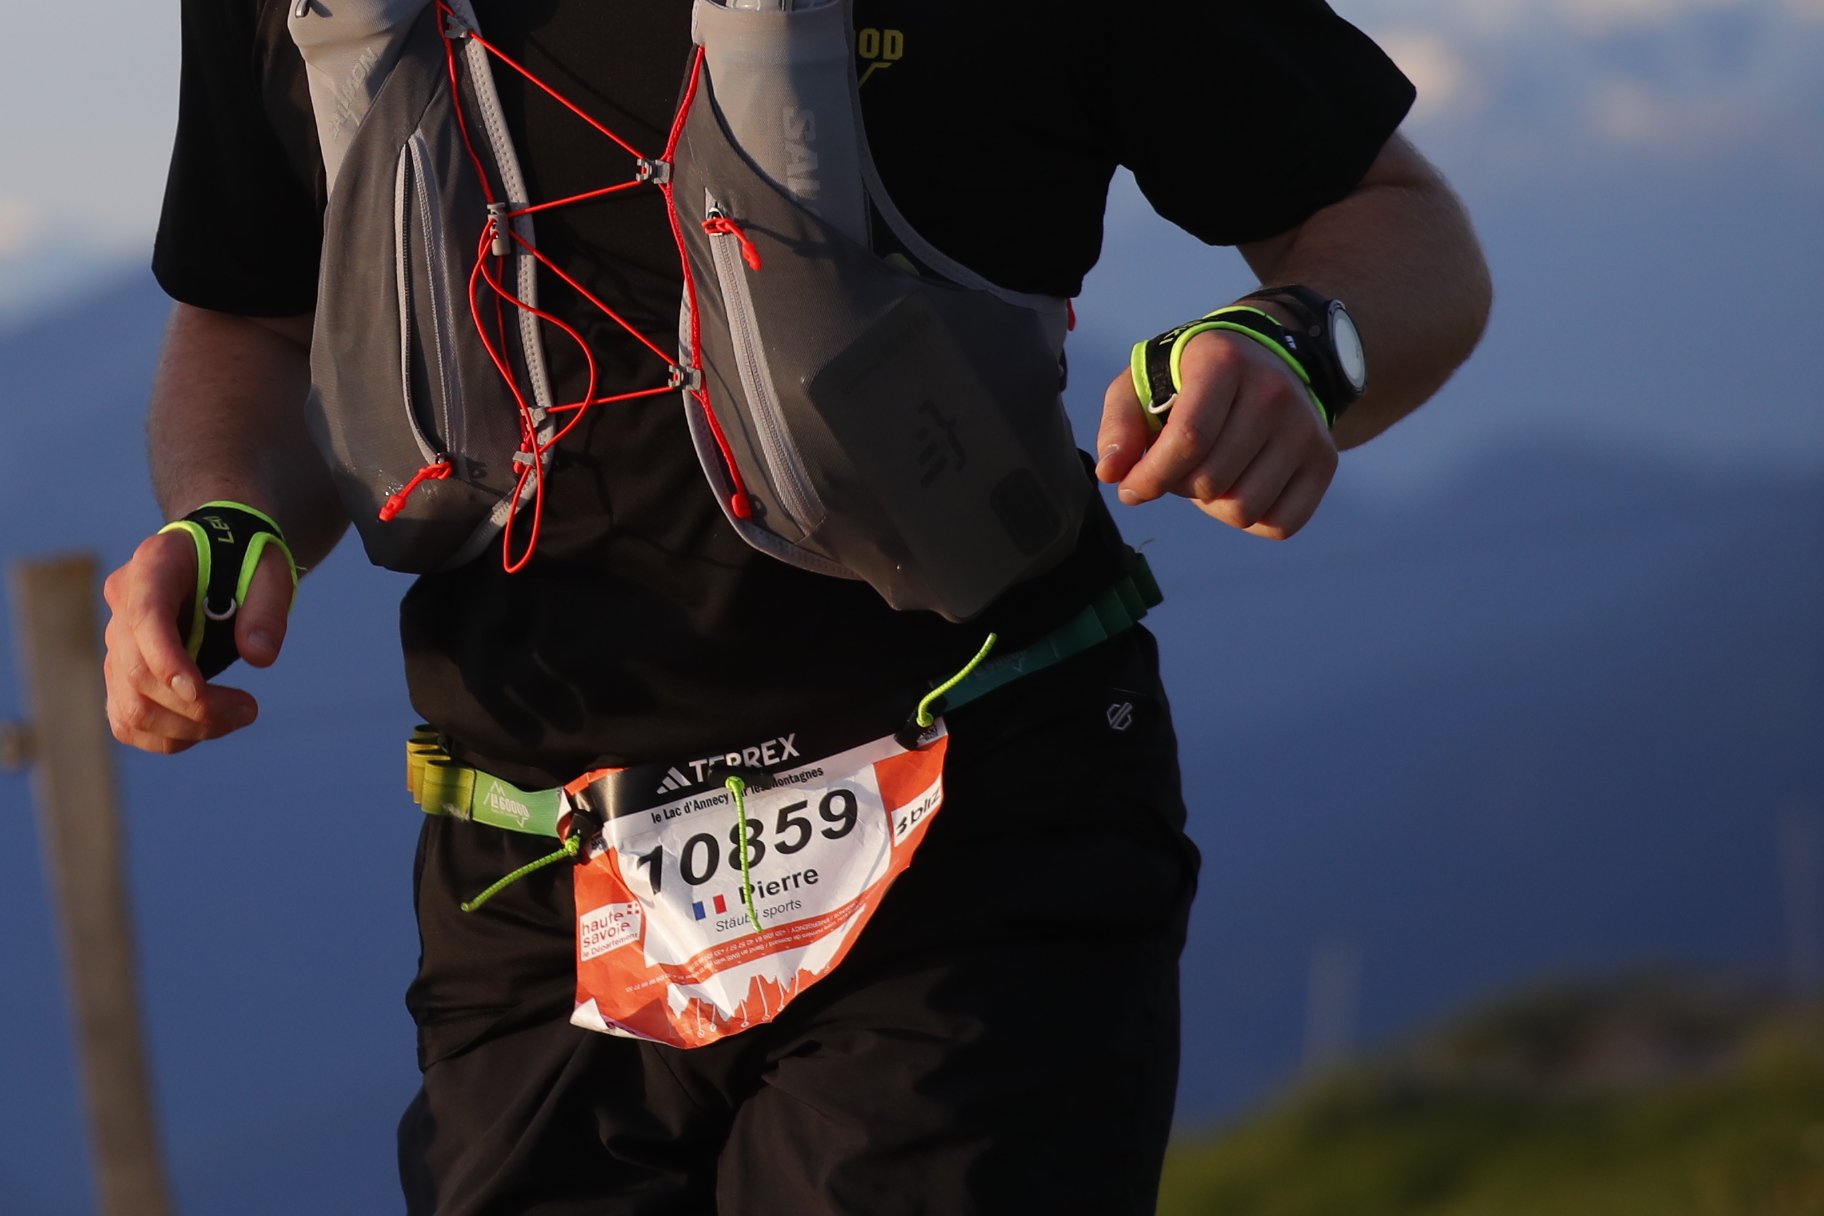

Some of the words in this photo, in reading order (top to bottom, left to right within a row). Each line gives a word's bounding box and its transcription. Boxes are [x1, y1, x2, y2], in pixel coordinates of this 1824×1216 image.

[651, 811, 662, 824] le
[663, 805, 682, 821] Lac
[684, 792, 729, 814] d'Annecy
[637, 789, 858, 896] 10859
[738, 868, 819, 904] Pierre
[582, 910, 624, 936] haute
[762, 899, 802, 919] sports
[583, 922, 630, 948] savoie
